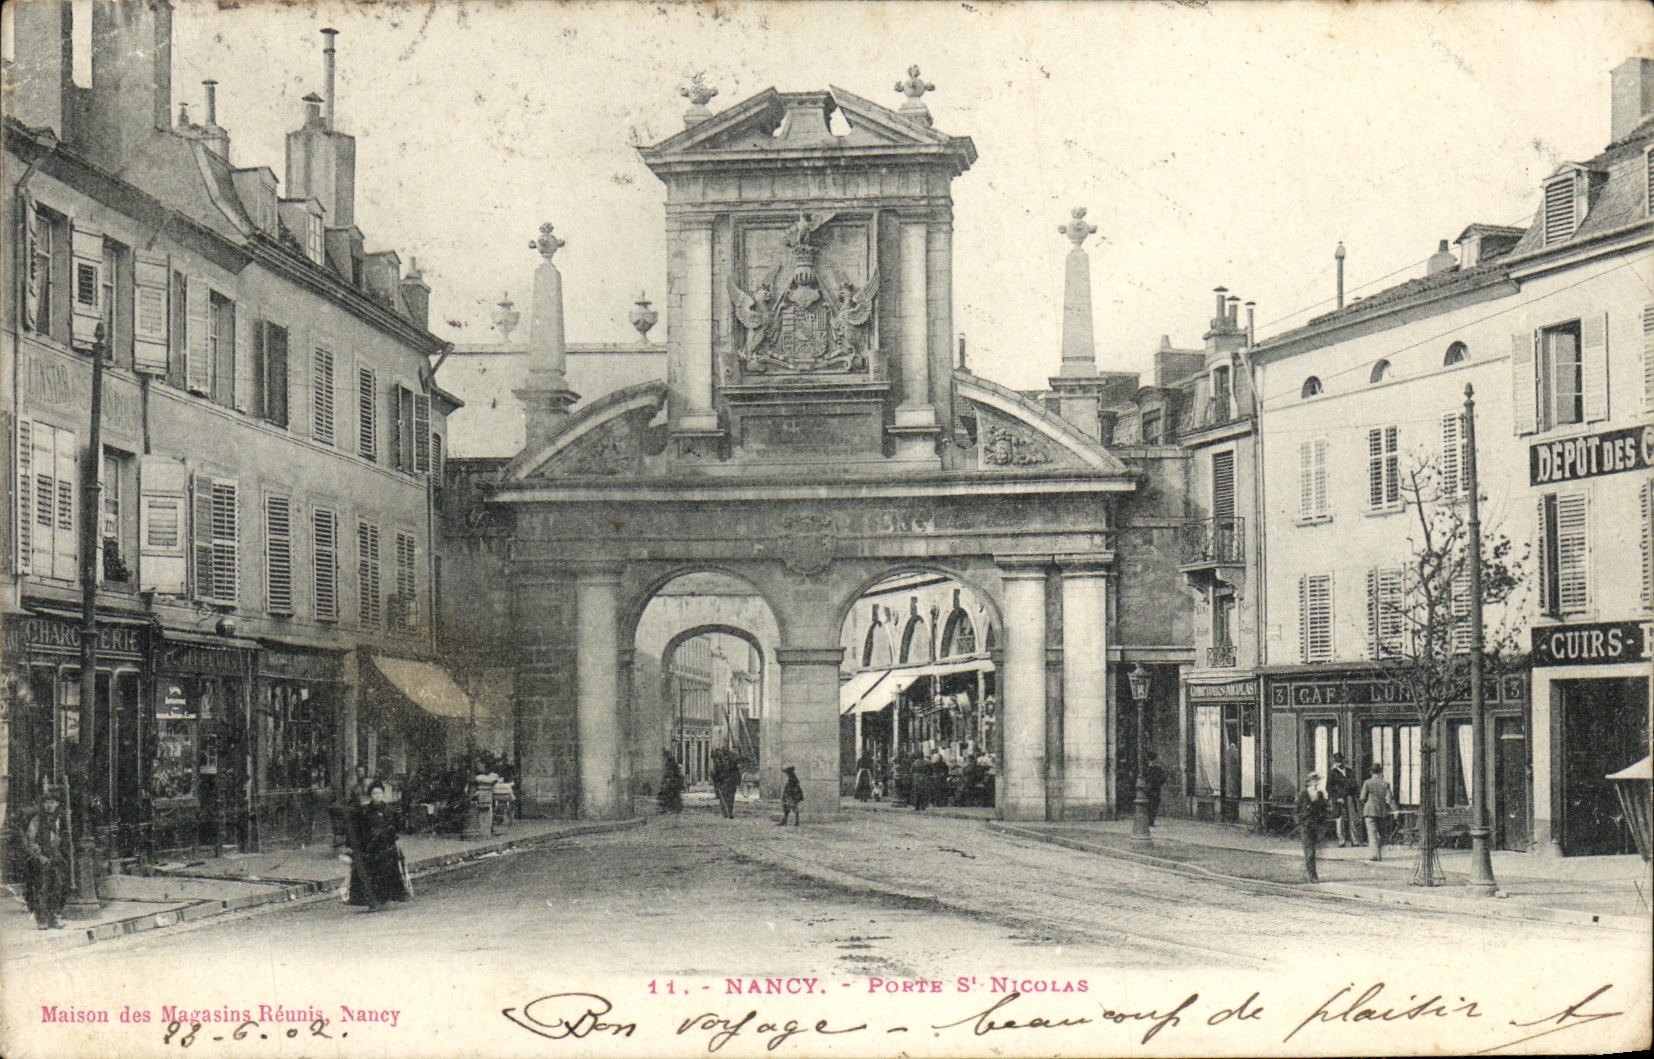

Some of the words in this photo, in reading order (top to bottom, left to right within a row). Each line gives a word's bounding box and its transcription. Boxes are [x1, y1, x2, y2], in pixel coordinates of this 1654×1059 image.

[1536, 436, 1599, 482] DÉPÔT
[1602, 437, 1636, 472] DES
[26, 619, 139, 650] CHARCERIE
[1551, 629, 1622, 659] CUIRS
[1276, 688, 1284, 704] 3
[1206, 992, 1264, 1026] de
[1283, 982, 1482, 1043] plaisir
